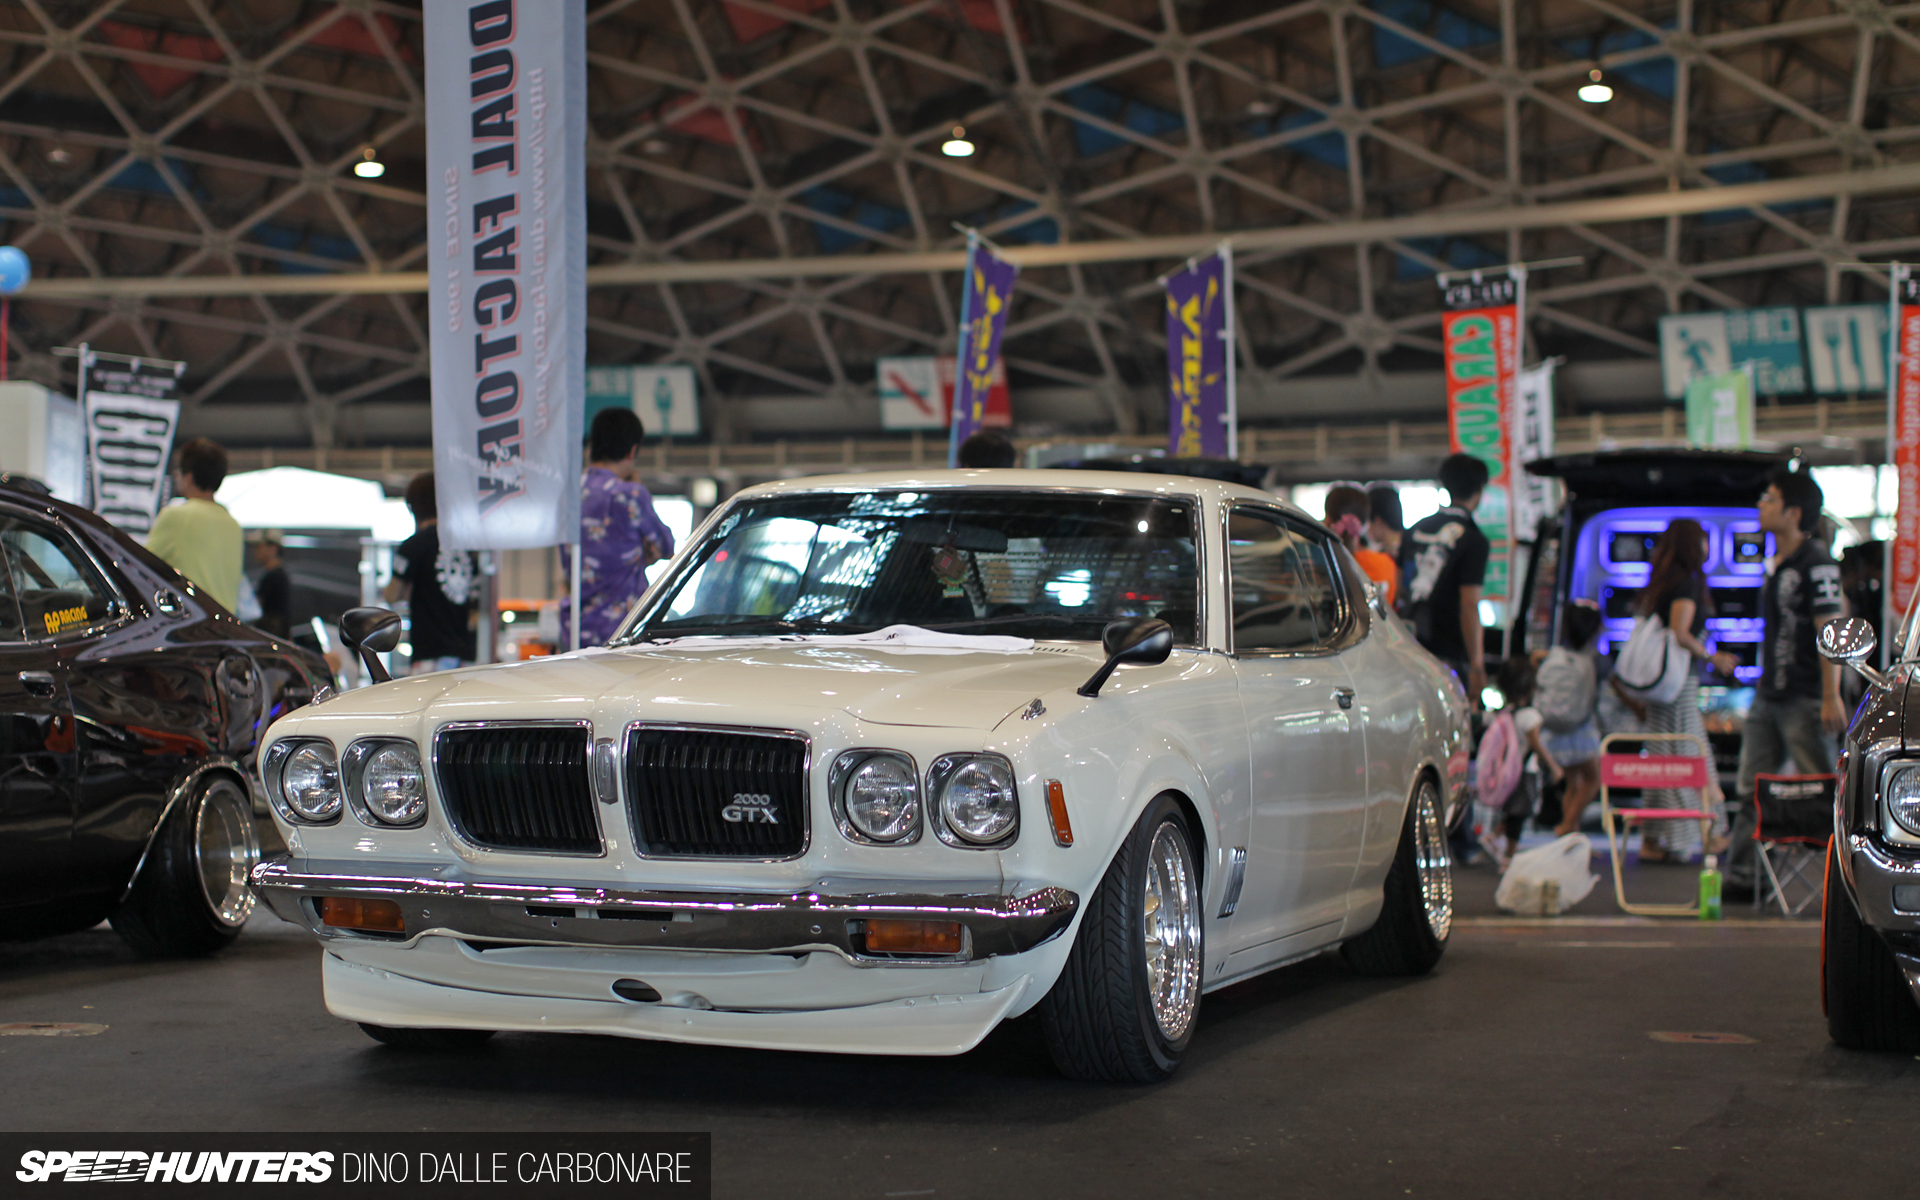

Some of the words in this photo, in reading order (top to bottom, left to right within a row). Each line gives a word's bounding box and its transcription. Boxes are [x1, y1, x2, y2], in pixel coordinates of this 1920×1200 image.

[59, 606, 88, 625] RACING
[733, 793, 770, 805] 2000
[721, 805, 778, 824] GTX
